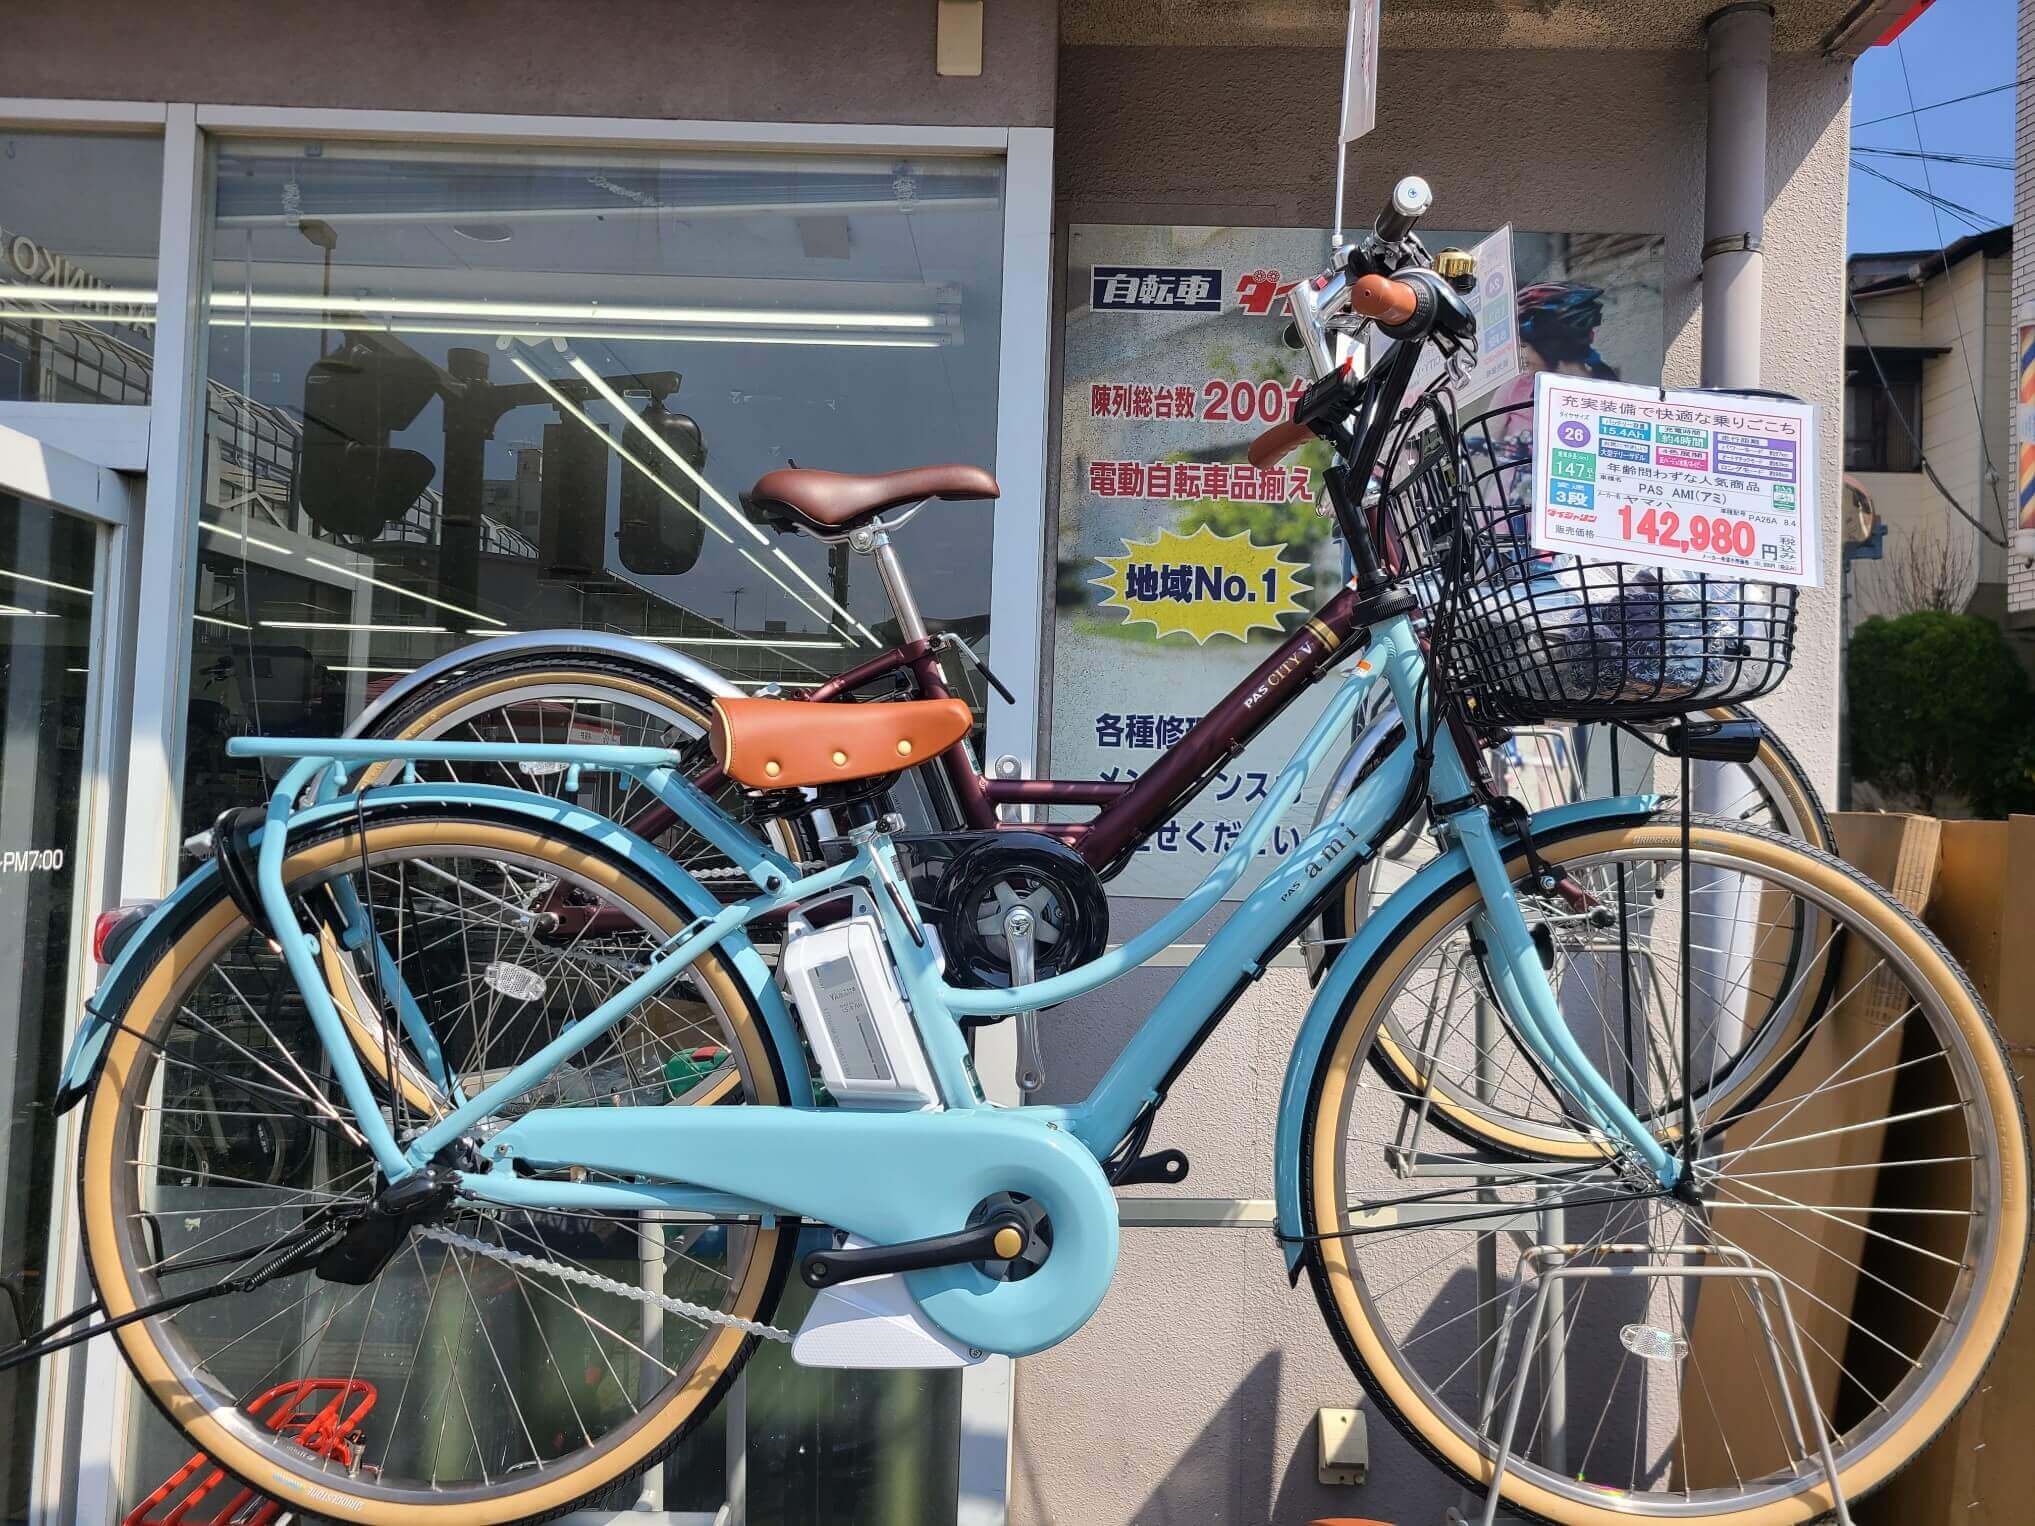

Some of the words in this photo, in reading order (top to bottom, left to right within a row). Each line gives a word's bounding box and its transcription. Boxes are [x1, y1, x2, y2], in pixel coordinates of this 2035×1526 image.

[1102, 273, 1212, 305] 自転車
[1091, 384, 1195, 418] 陳列総台数
[1561, 394, 1797, 436] 充実装備で快適な乗りごこち
[1564, 427, 1584, 442] 26
[1602, 427, 1646, 440] 15.4Ah
[1662, 434, 1704, 448] 約4時間
[1556, 461, 1585, 478] 147
[1606, 462, 1761, 493] 年齢問わずな人気商品
[1720, 464, 1765, 475] ロングモード
[1089, 461, 1313, 501] 電動自転車品揃え
[1638, 483, 1664, 496] PAS
[1555, 491, 1588, 507] 3段
[1623, 495, 1673, 509] ヤマハ
[1748, 514, 1778, 525] PA26A
[1554, 524, 1596, 539] 販売価格
[1617, 504, 1756, 558] 142,980
[1761, 543, 1778, 560] 円
[1125, 563, 1277, 603] 地域No.1
[1244, 684, 1269, 709] PAS
[1268, 655, 1302, 687] CITY
[1299, 639, 1315, 656] V
[1095, 713, 1206, 750] 各種修
[0, 849, 64, 873] PM7:00
[1280, 880, 1301, 903] PAS
[1305, 822, 1360, 879] ami
